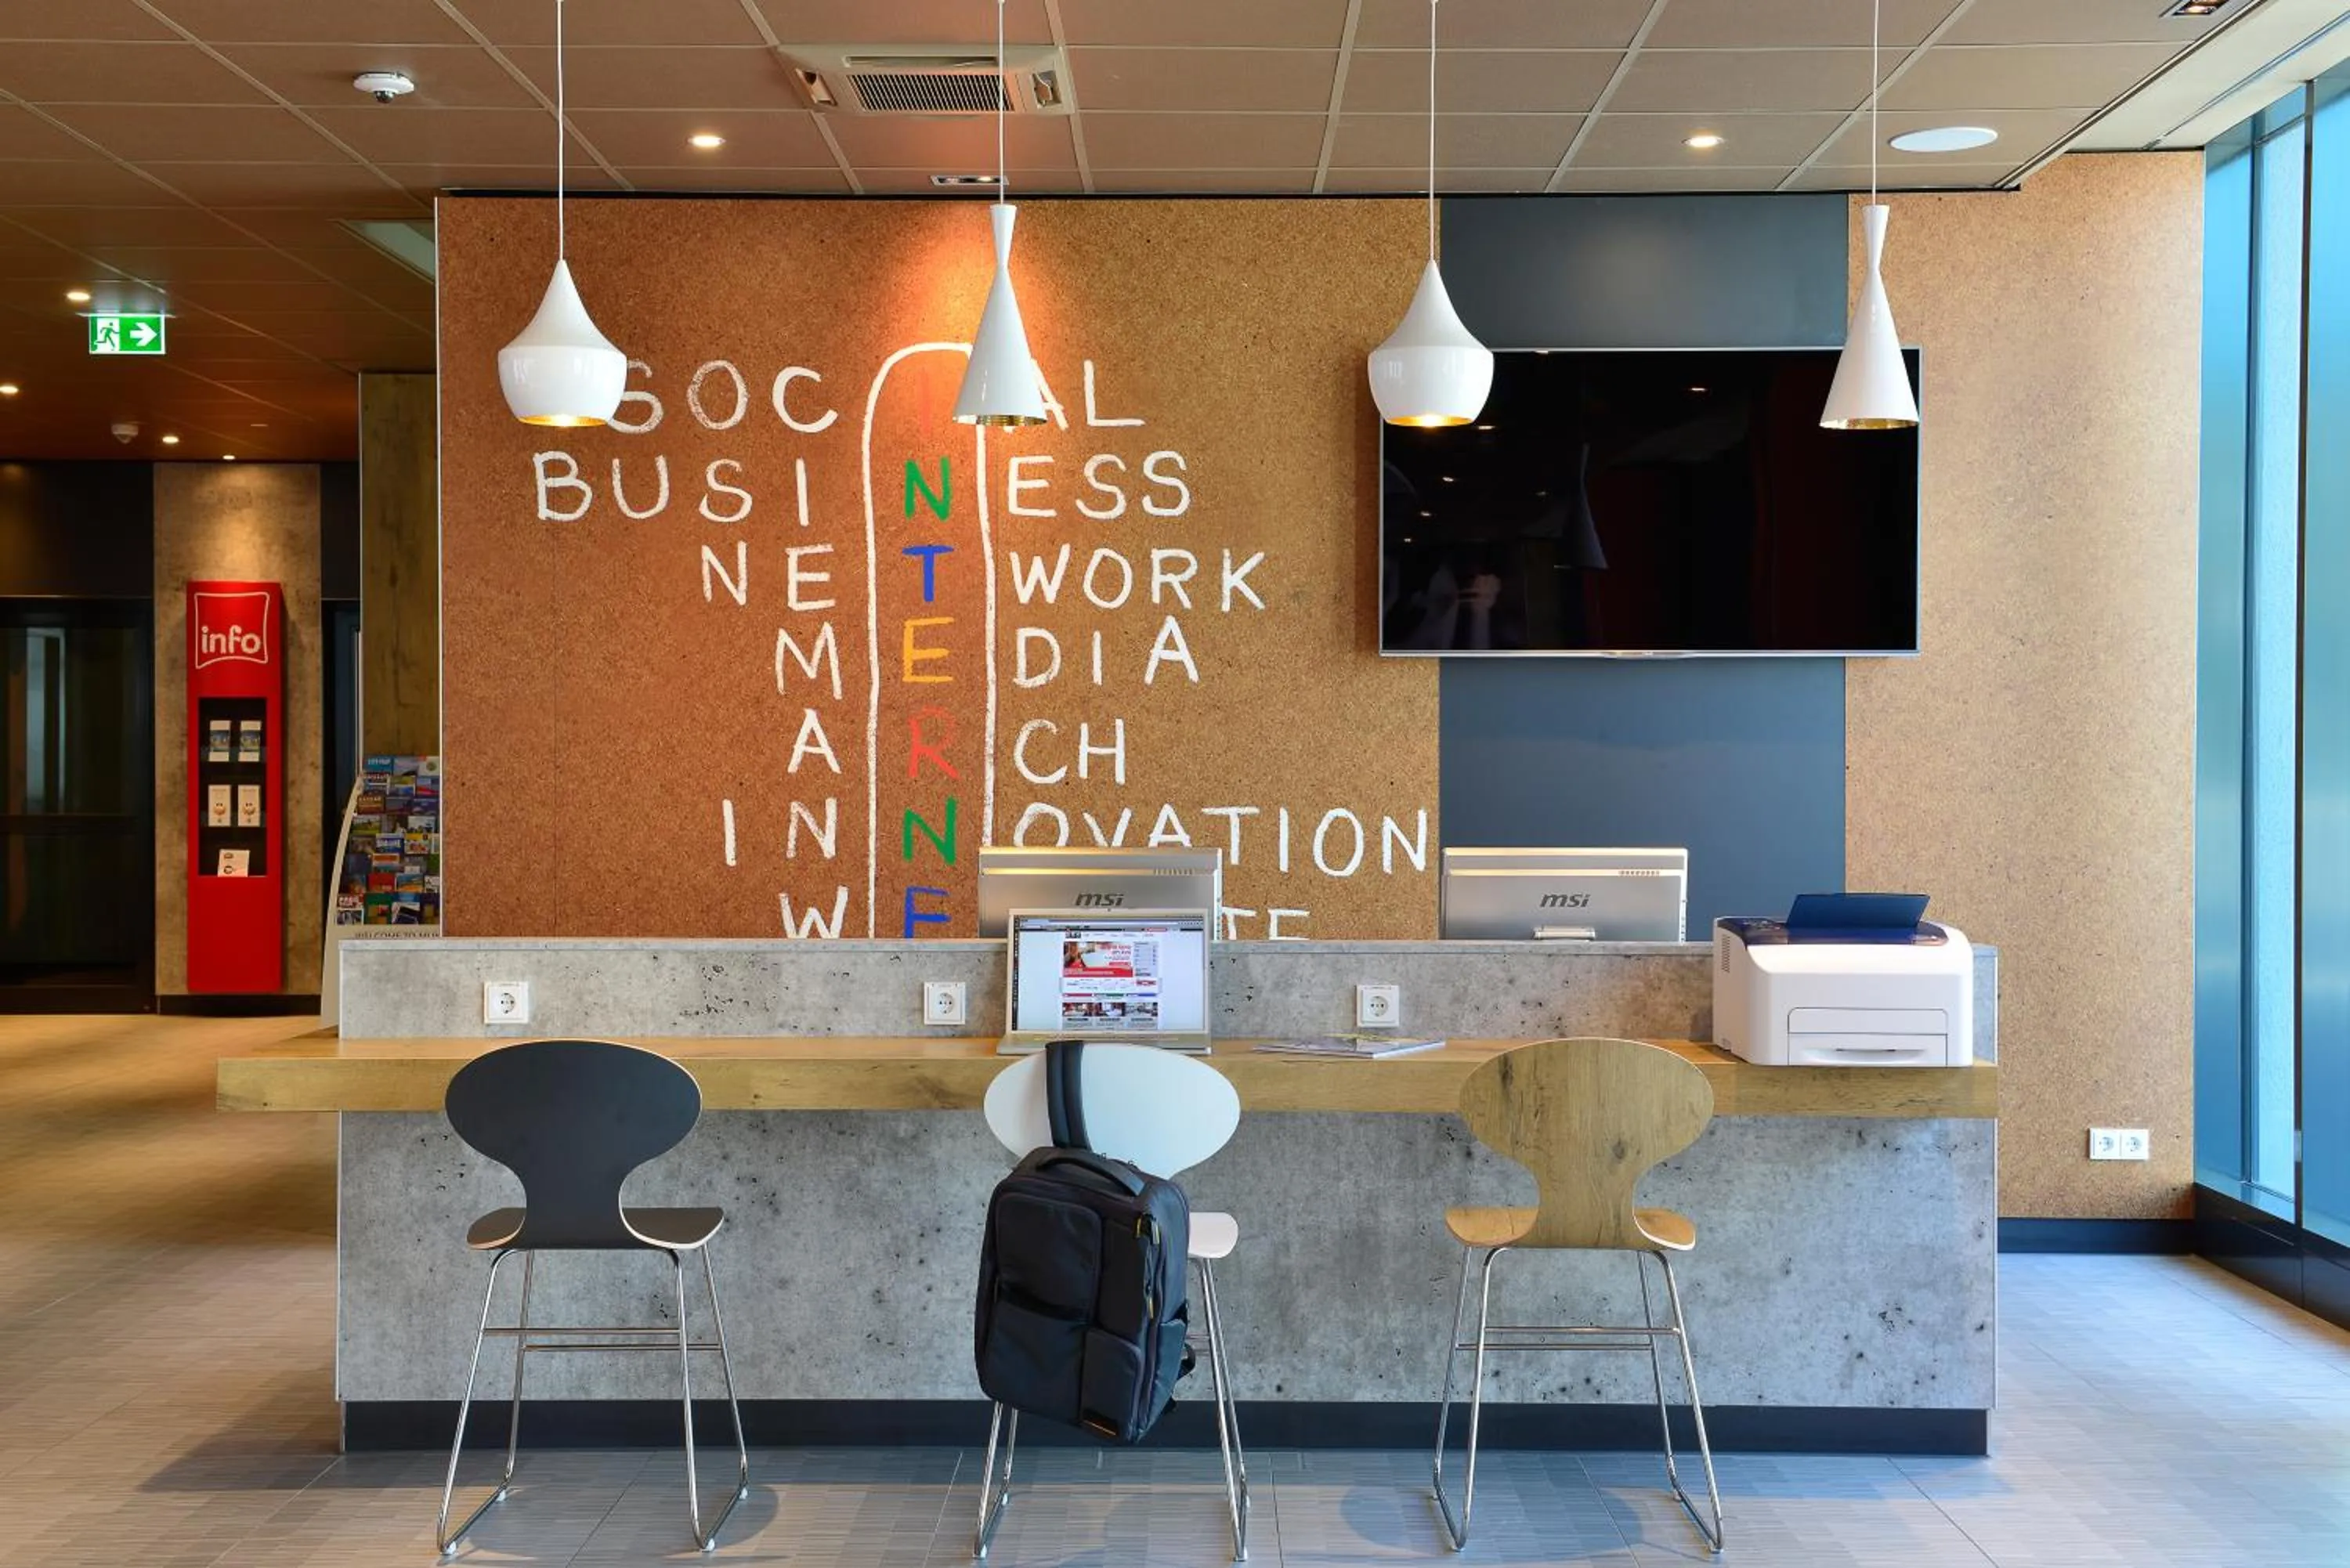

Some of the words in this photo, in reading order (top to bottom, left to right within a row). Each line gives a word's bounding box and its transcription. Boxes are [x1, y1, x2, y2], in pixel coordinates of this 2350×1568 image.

[201, 624, 262, 654] info
[1076, 894, 1124, 906] msi
[1540, 894, 1591, 907] msi
